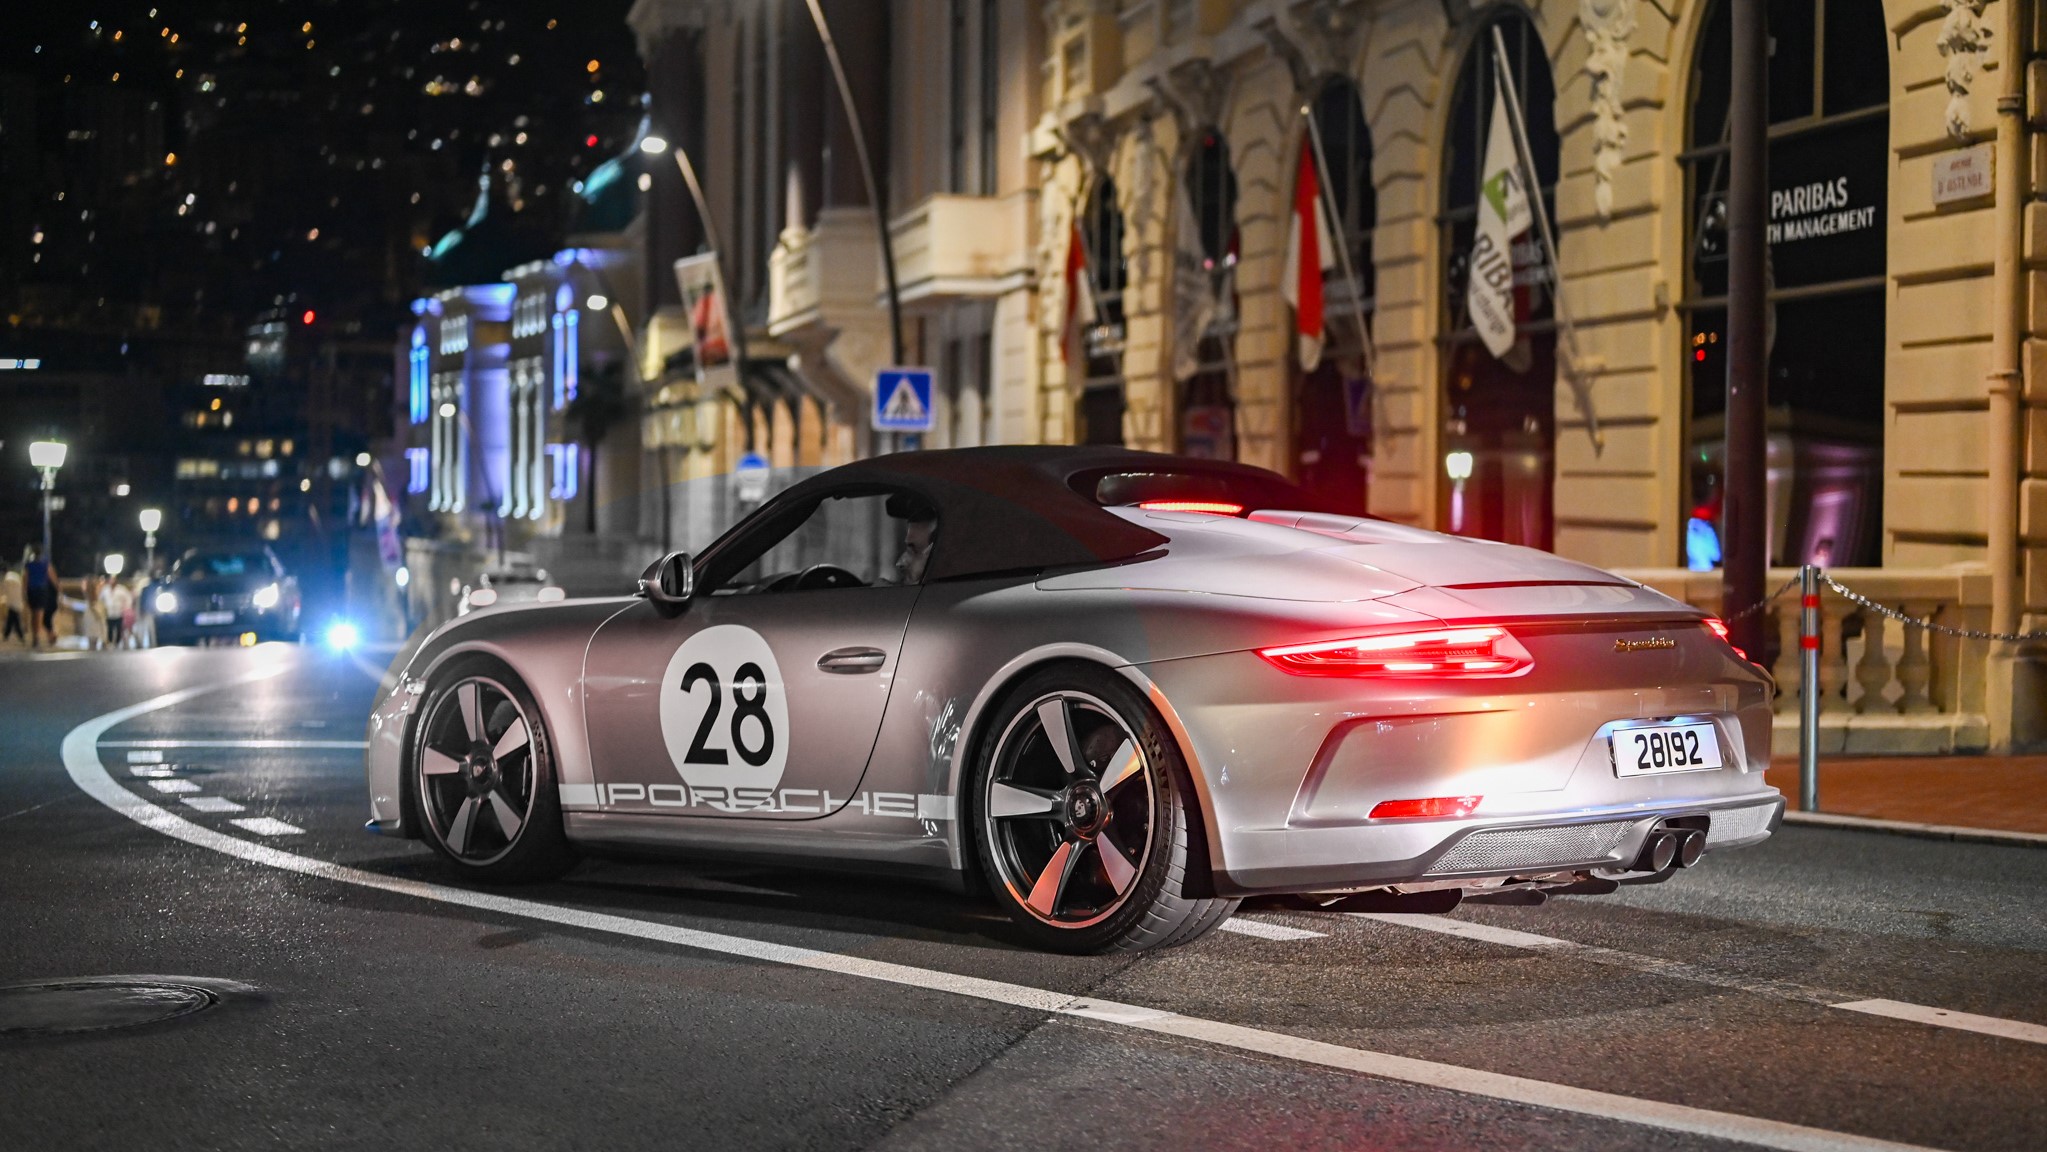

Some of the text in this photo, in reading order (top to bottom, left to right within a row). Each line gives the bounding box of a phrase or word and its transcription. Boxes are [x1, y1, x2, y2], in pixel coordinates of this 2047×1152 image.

[1771, 176, 1848, 219] PARIBAS
[1784, 205, 1876, 242] MANAGEMENT
[680, 662, 774, 766] 28
[1634, 730, 1703, 769] 28192
[609, 784, 915, 819] PORSCHE
